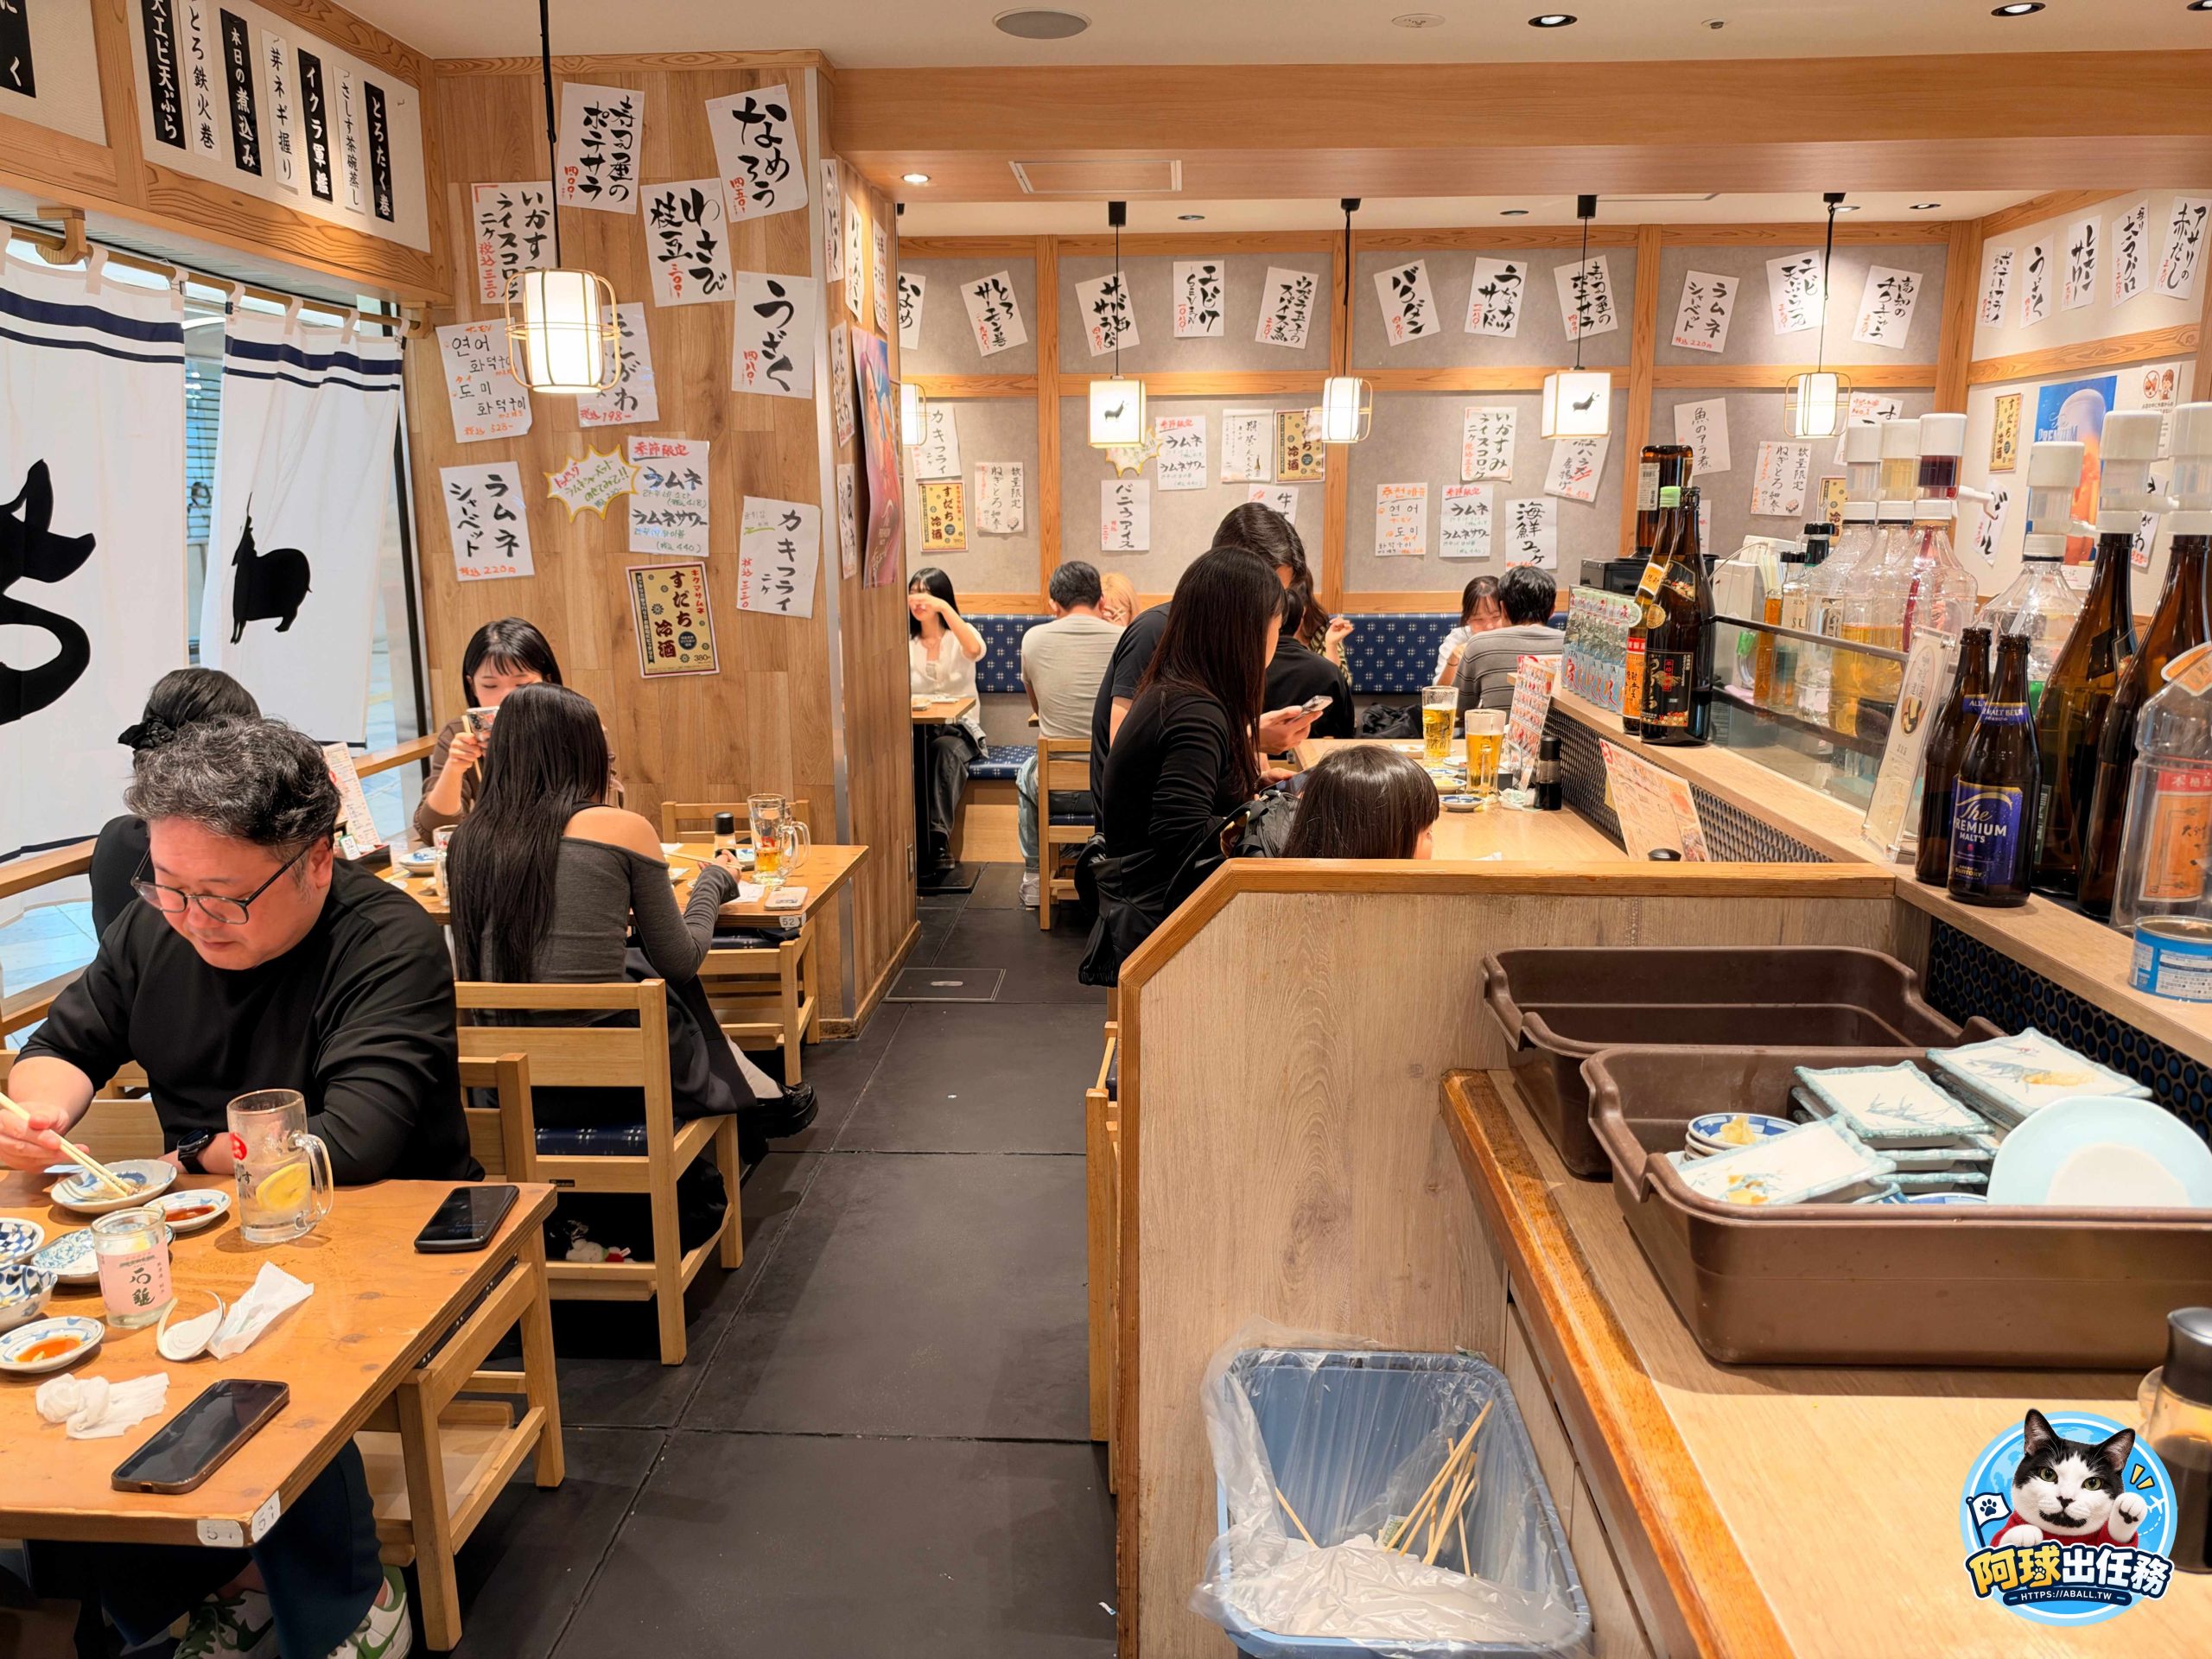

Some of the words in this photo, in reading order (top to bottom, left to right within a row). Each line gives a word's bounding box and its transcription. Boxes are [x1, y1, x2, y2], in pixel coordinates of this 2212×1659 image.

[189, 5, 215, 149] とろ鉄火巻
[232, 28, 256, 168] 本日の煮込み
[270, 47, 292, 181] 芽ネギ握り
[307, 67, 330, 195] イクラ軍艦
[341, 82, 359, 206] さしす茶碗蒸し
[372, 97, 391, 216] とろたく巻
[578, 100, 609, 202] ポテサラ
[609, 95, 636, 202] 寿司屋の
[522, 190, 551, 270] いかす
[650, 191, 691, 263] 枝豆
[680, 188, 728, 296] わさび
[2082, 225, 2095, 290] レモン
[2166, 202, 2191, 289] 赤だし
[2181, 206, 2207, 281] アサリの
[991, 278, 1014, 320] とろ
[1391, 265, 1426, 335] バクダン
[1478, 282, 1500, 329] サンド
[1494, 264, 1522, 333] うなカツ
[1684, 281, 1704, 332] シャーベット
[1799, 258, 1817, 296] エビ
[2029, 246, 2045, 317] うざく
[753, 279, 795, 392] うざく
[1271, 283, 1294, 342] スパイス煮
[1704, 283, 1728, 339] ラムネ
[633, 442, 690, 457] 季節限定
[931, 409, 948, 475] カキフライ
[1159, 460, 1205, 474] ラムネサワー
[1166, 434, 1203, 448] ラムネ
[1474, 413, 1490, 480] ライスコロッケ
[1490, 412, 1513, 472] いかすみ
[1692, 407, 1712, 471] 魚のアラ煮
[643, 467, 702, 491] ラムネ
[943, 486, 954, 522] すだち
[1451, 502, 1489, 516] ラムネ
[449, 482, 484, 558] シャーベット
[485, 474, 520, 558] ラムネ
[632, 509, 708, 527] ラムネサワー
[931, 516, 943, 541] 冷酒
[1116, 483, 1135, 549] バニラアイス
[1442, 528, 1490, 540] ラムネサワー
[1516, 501, 1545, 564] 海鮮ユッケ
[775, 509, 802, 612] カキフライ
[669, 570, 692, 627] すだち
[654, 619, 677, 658] 冷酒
[1954, 817, 2007, 836] REMIUM
[1960, 799, 1993, 822] The
[1960, 832, 1986, 843] MALT'S
[782, 918, 794, 926] 52
